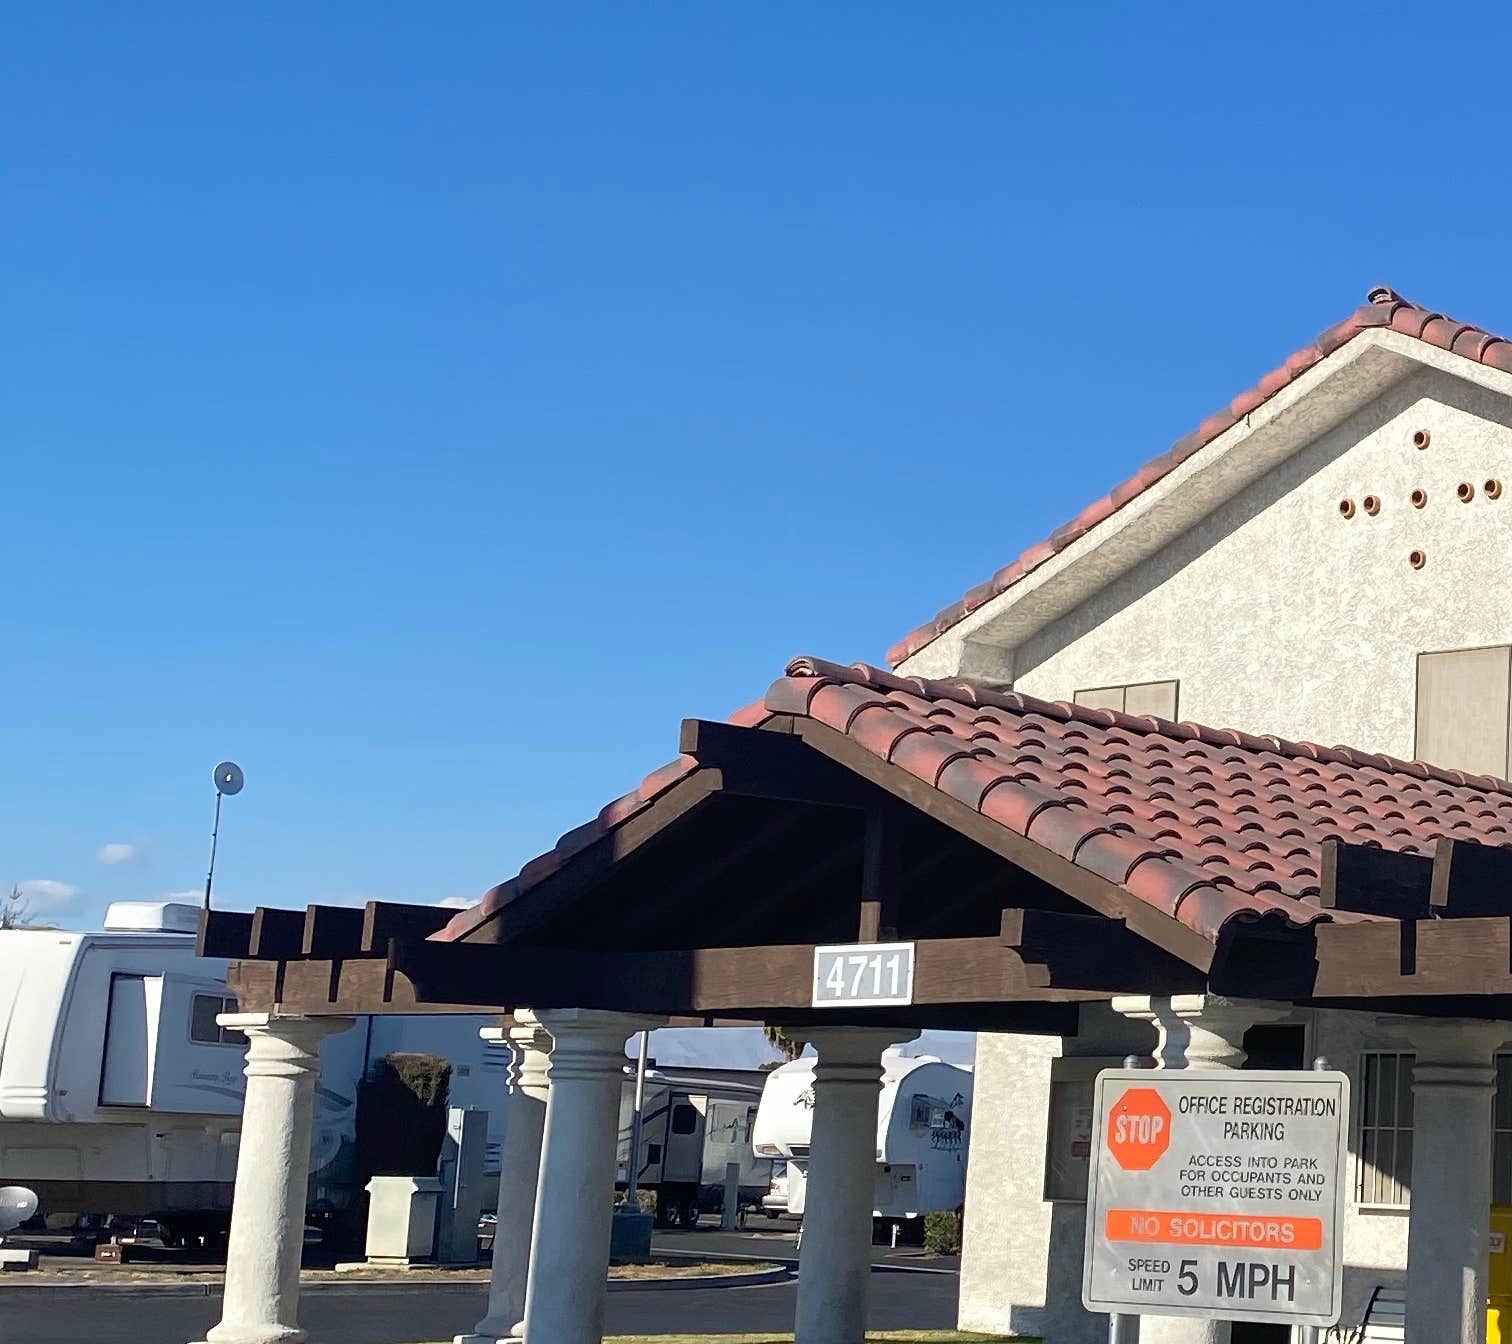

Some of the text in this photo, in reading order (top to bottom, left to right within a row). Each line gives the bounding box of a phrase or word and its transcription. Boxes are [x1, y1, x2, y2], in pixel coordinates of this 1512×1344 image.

[826, 954, 900, 997] 4711
[1179, 1096, 1336, 1117] OFFICE REGISTRATION
[1115, 1114, 1164, 1145] STOP
[1223, 1122, 1285, 1141] PARKING
[1188, 1155, 1318, 1170] ACCESS INTO PARK
[1180, 1170, 1325, 1185] FOR OCCUPANTS AND
[1181, 1185, 1323, 1202] OTHER GUESTS ONLY
[1130, 1216, 1295, 1243] NO SOLICITORS
[1128, 1258, 1170, 1273] SPEED
[1132, 1278, 1164, 1292] LIMIT
[1177, 1259, 1296, 1302] 5 MPH
